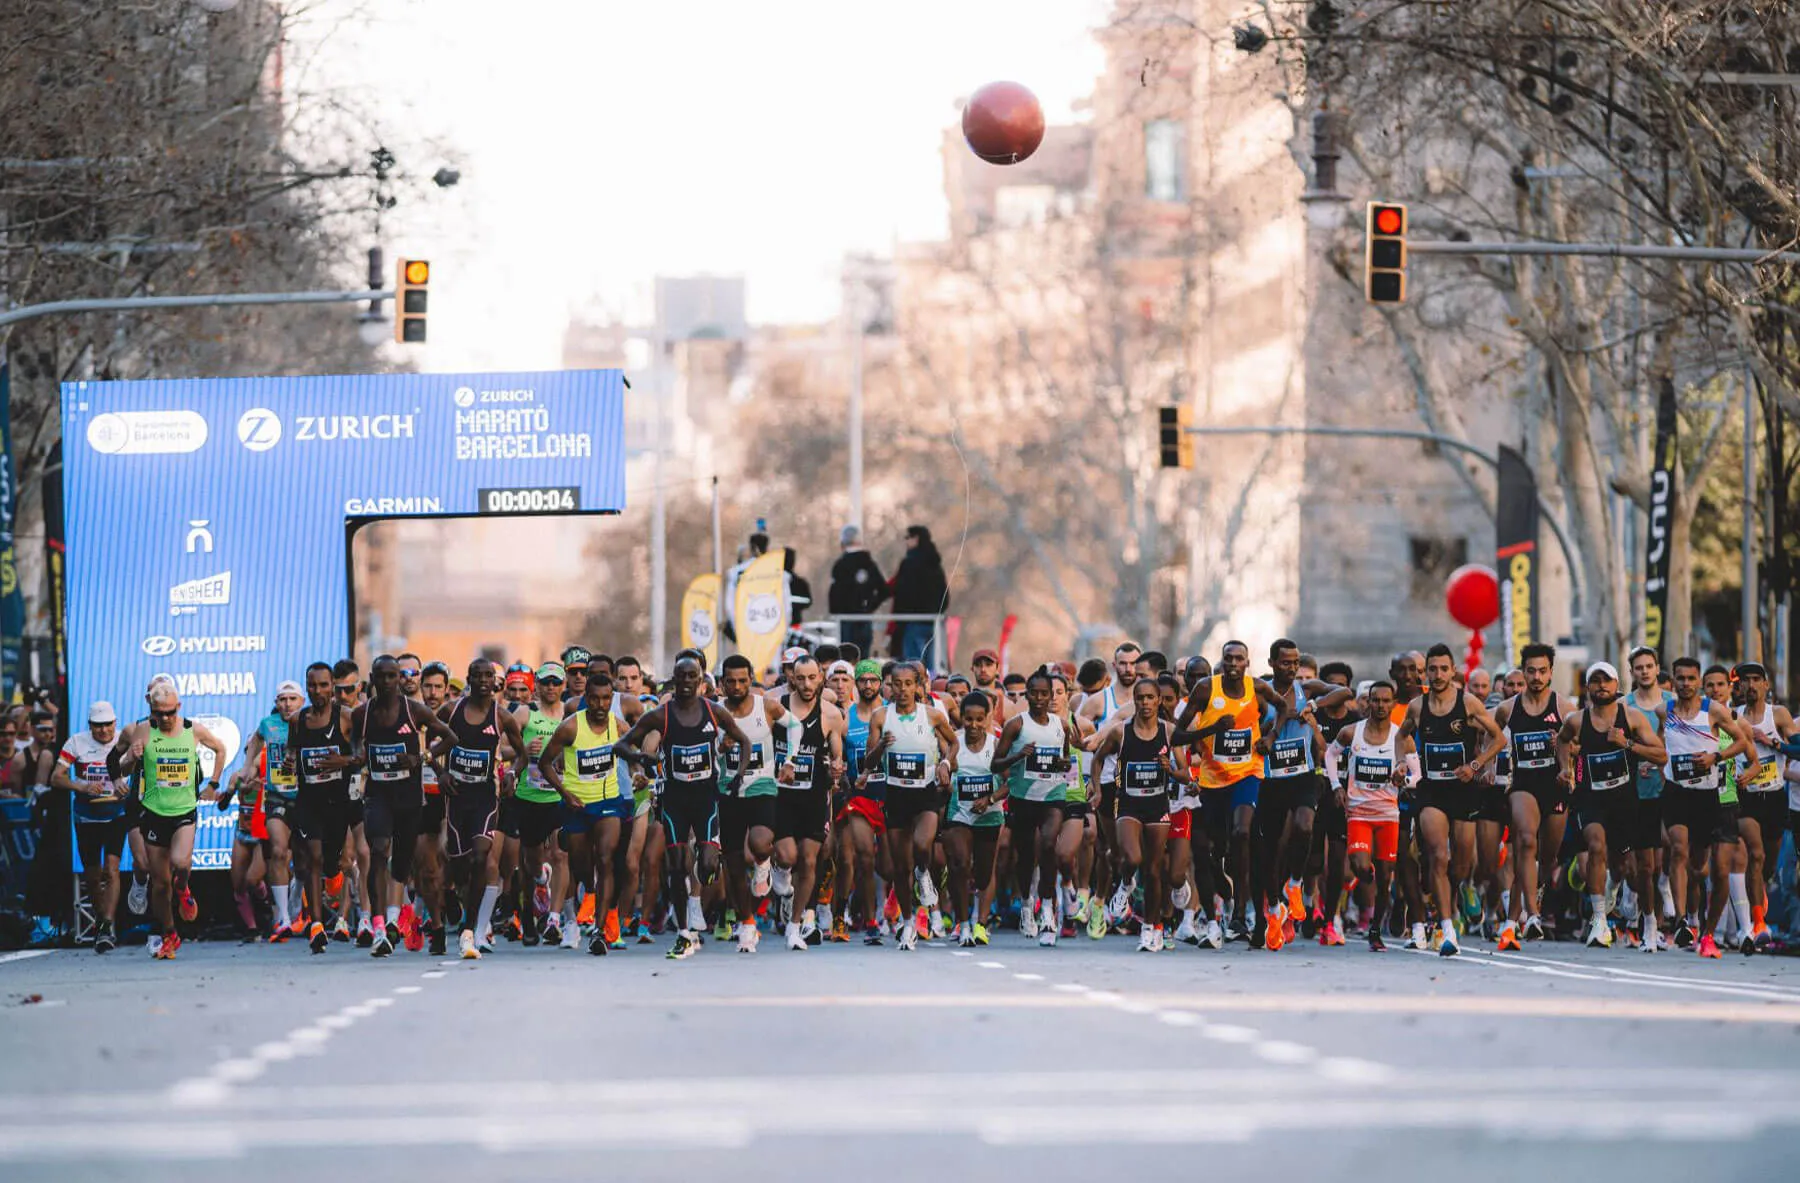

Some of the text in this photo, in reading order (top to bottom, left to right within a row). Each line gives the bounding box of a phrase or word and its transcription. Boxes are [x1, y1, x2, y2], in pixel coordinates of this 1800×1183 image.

[480, 390, 533, 402] ZURICH
[295, 414, 414, 441] ZURICH
[455, 405, 549, 434] MARATÓ
[134, 430, 190, 442] Barcelona
[456, 433, 591, 460] BARCELONA
[488, 489, 574, 511] 00:00:04
[180, 635, 266, 653] HYUNDAI
[176, 671, 257, 695] YAMAHA
[455, 756, 483, 768] COLLINS
[681, 754, 703, 765] PACER
